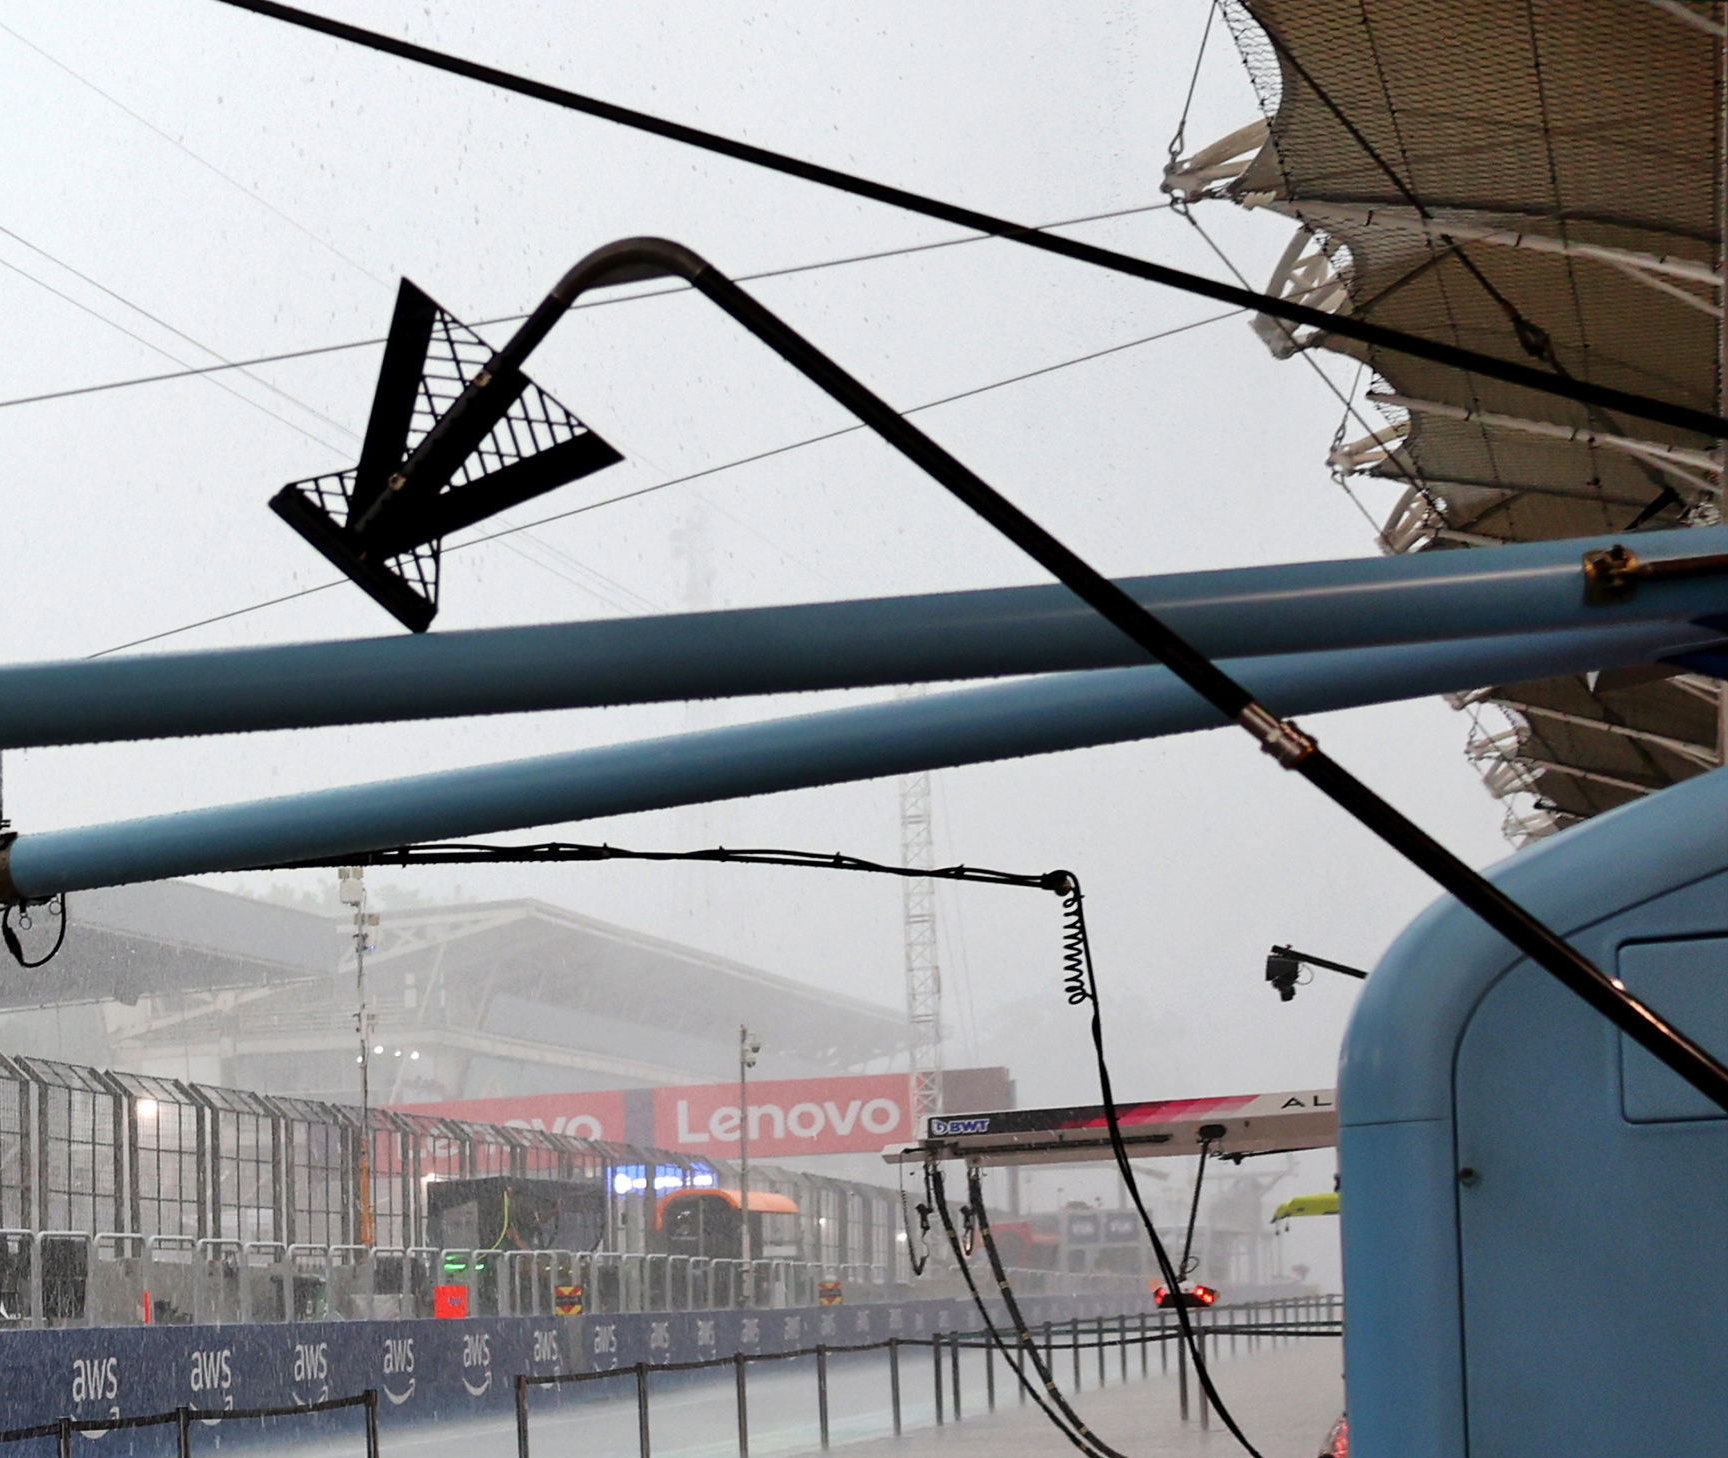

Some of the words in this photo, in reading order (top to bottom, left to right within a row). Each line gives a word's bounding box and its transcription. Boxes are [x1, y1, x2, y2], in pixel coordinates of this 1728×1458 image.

[676, 1098, 900, 1143] Lenovo
[950, 1119, 989, 1134] BWT
[294, 1343, 327, 1381] aws
[384, 1338, 414, 1374] aws
[463, 1334, 490, 1367] aws
[534, 1330, 557, 1361] aws
[73, 1357, 117, 1402] aws
[191, 1349, 231, 1391] aws
